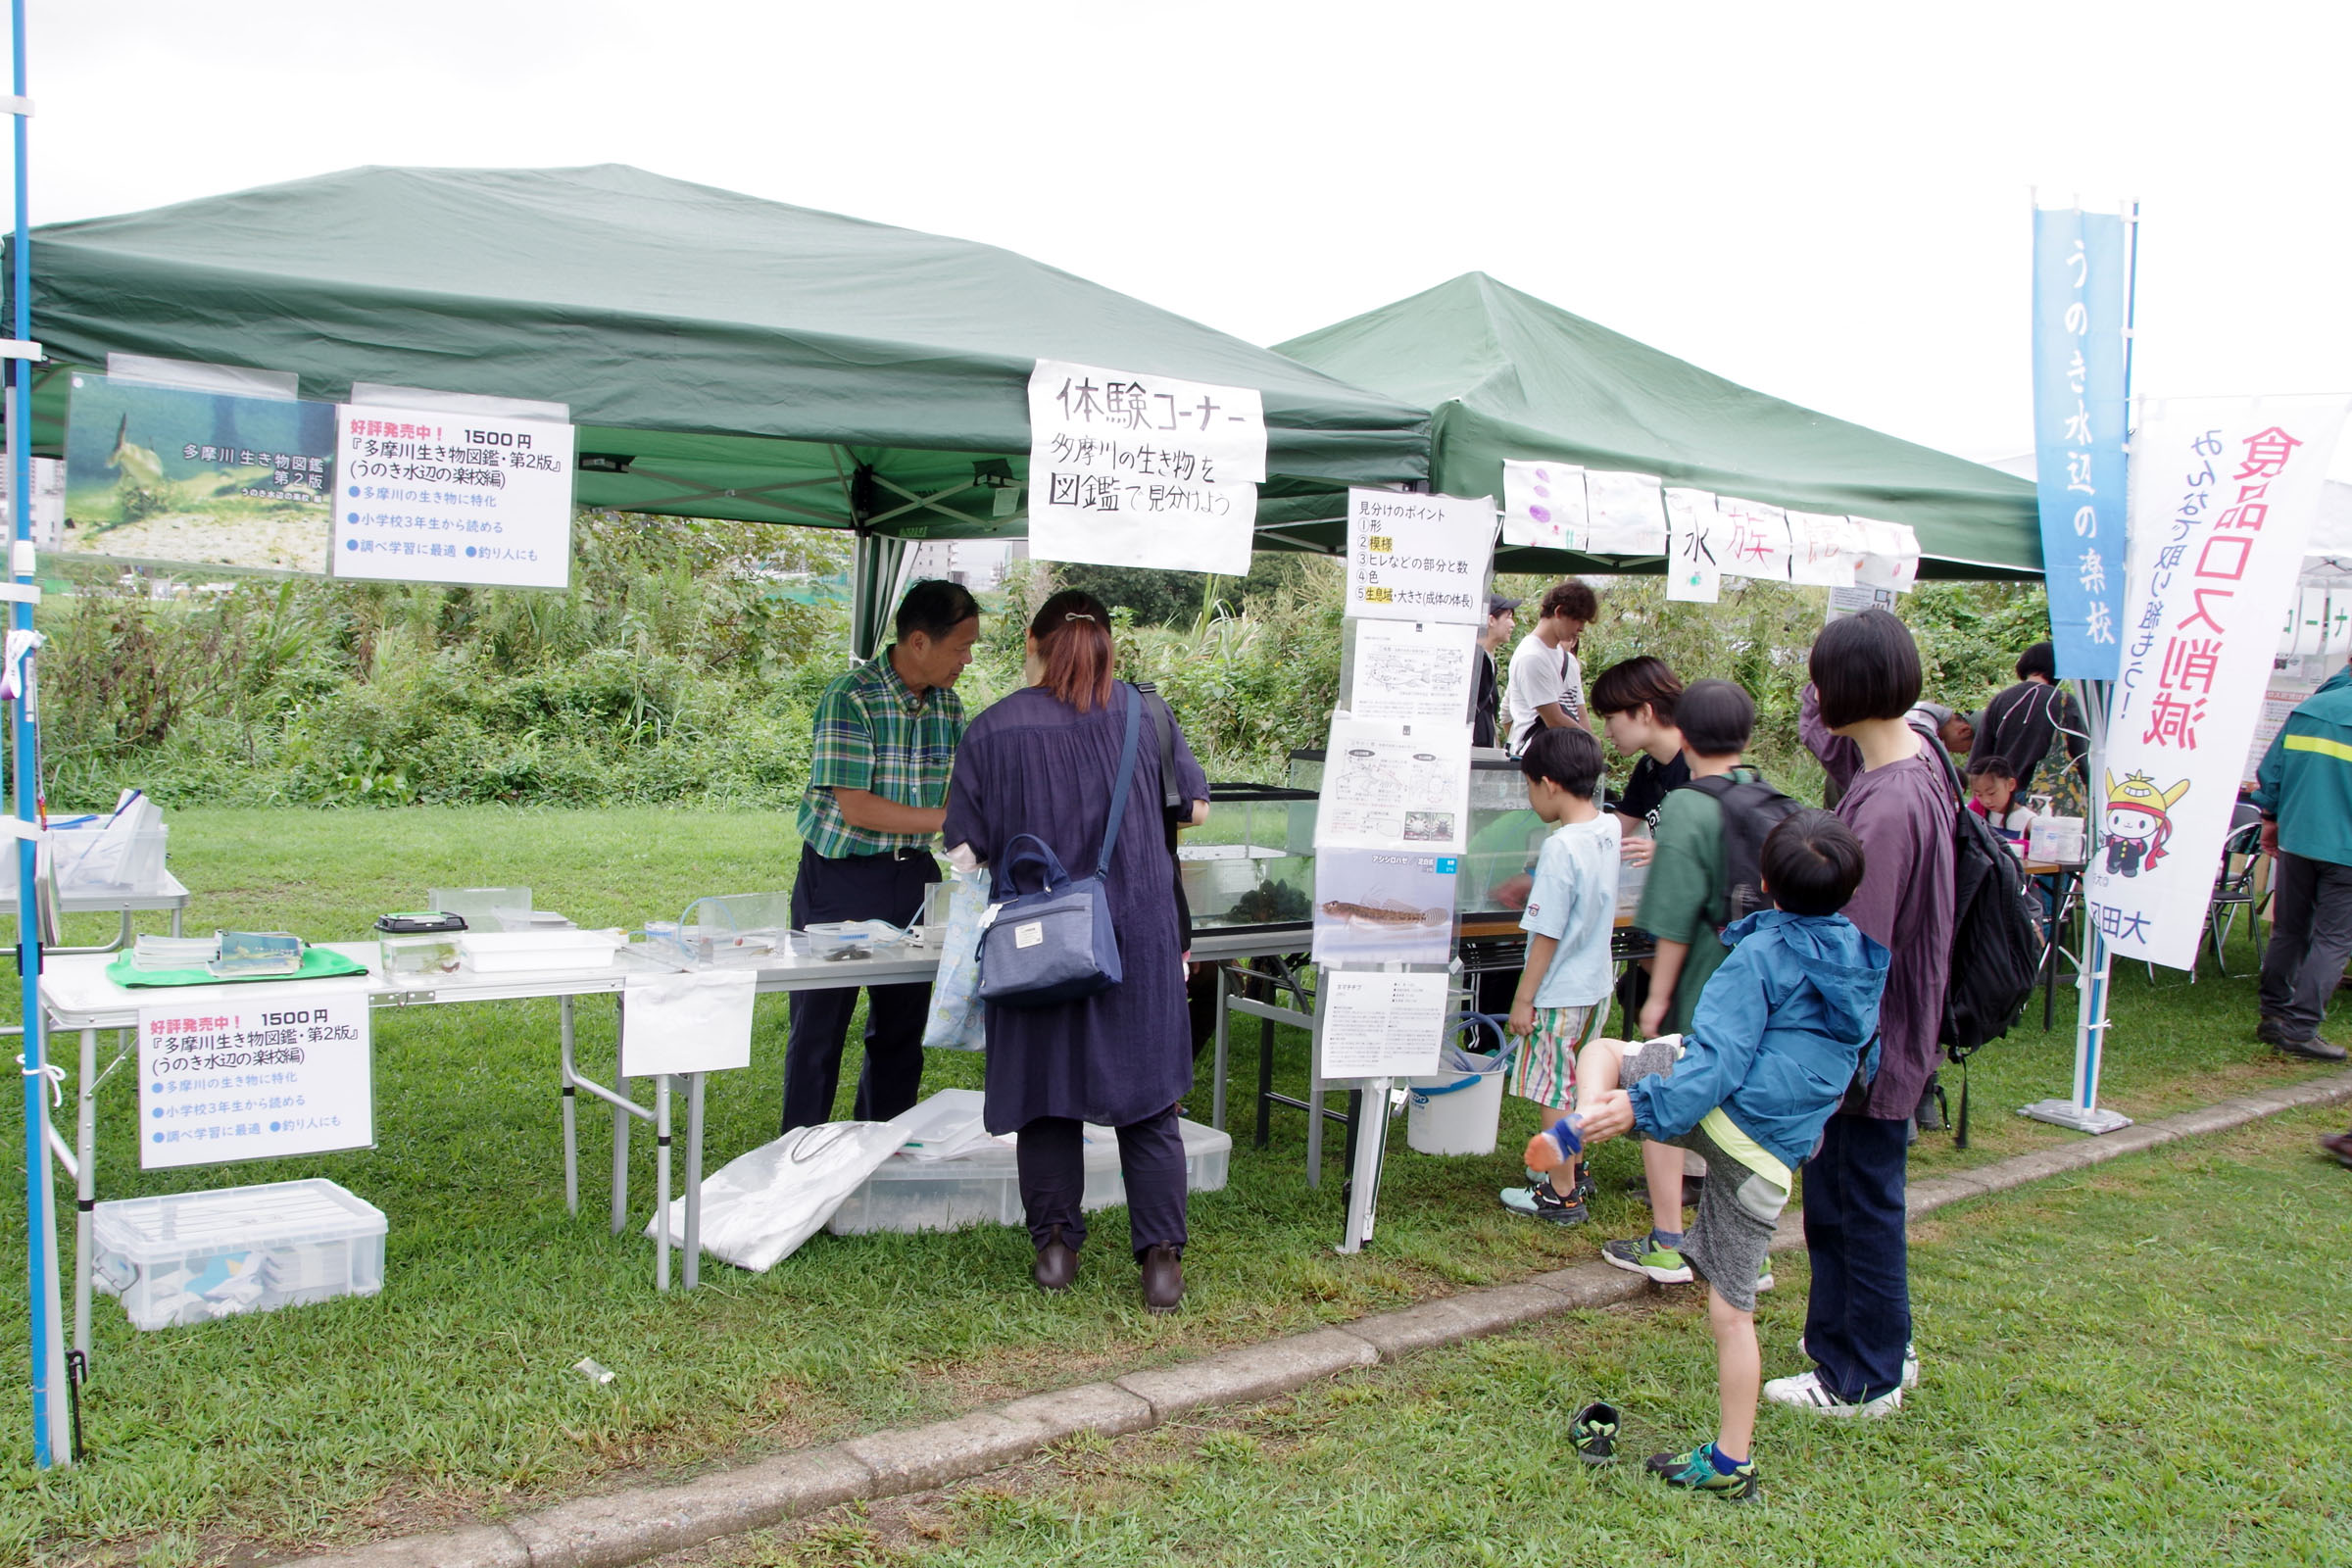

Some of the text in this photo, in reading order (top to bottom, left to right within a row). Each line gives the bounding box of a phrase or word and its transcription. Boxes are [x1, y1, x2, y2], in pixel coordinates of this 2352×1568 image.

[1055, 377, 1247, 431] 体験コーナー
[351, 419, 443, 441] 好評発売中！
[2064, 239, 2116, 646] うのき水辺の楽校
[183, 443, 324, 472] 多摩川 生き物図鑑
[1051, 431, 1215, 484] 多摩川の生き物を
[274, 470, 323, 490] 第2版
[349, 460, 507, 490] (うのき水辺の楽校編)
[1049, 471, 1230, 516] 図鑑で見分けよう
[1359, 501, 1446, 522] 見分けのポイント
[150, 1015, 240, 1036] 好評発売中！
[152, 1048, 306, 1077] (うのき水辺の楽校編)
